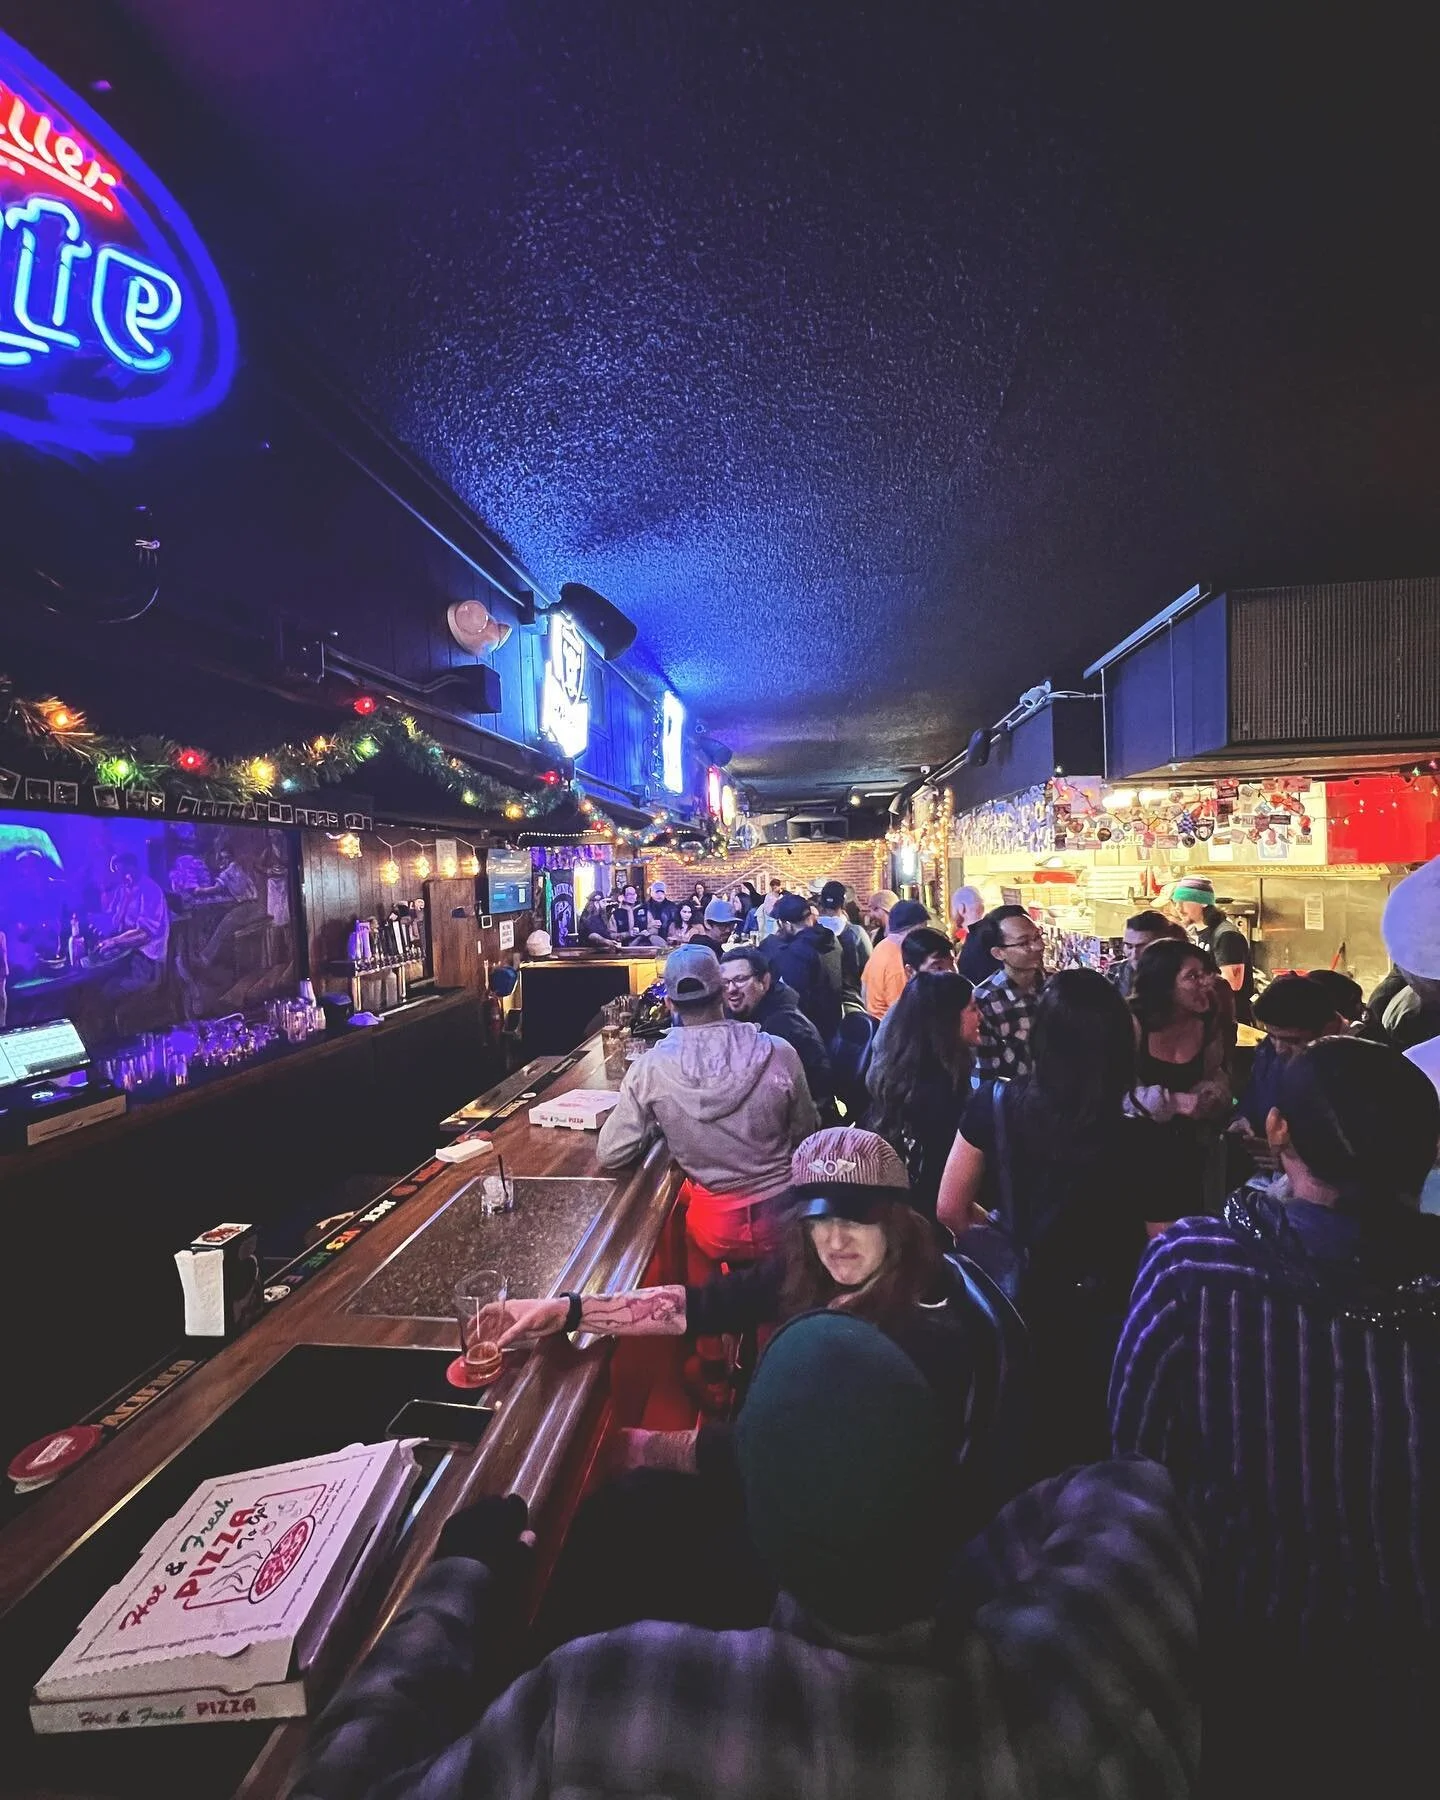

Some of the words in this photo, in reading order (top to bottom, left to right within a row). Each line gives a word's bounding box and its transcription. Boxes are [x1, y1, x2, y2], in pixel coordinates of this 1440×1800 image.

[0, 94, 117, 188] ller
[118, 1583, 167, 1631] Hot
[165, 1560, 188, 1577] &
[180, 1497, 234, 1552] Fresh
[173, 1507, 256, 1600] PIZZA
[78, 1711, 111, 1726] Hot
[116, 1710, 131, 1723] &
[137, 1706, 186, 1724] Fresh
[196, 1698, 256, 1715] PIZZA
